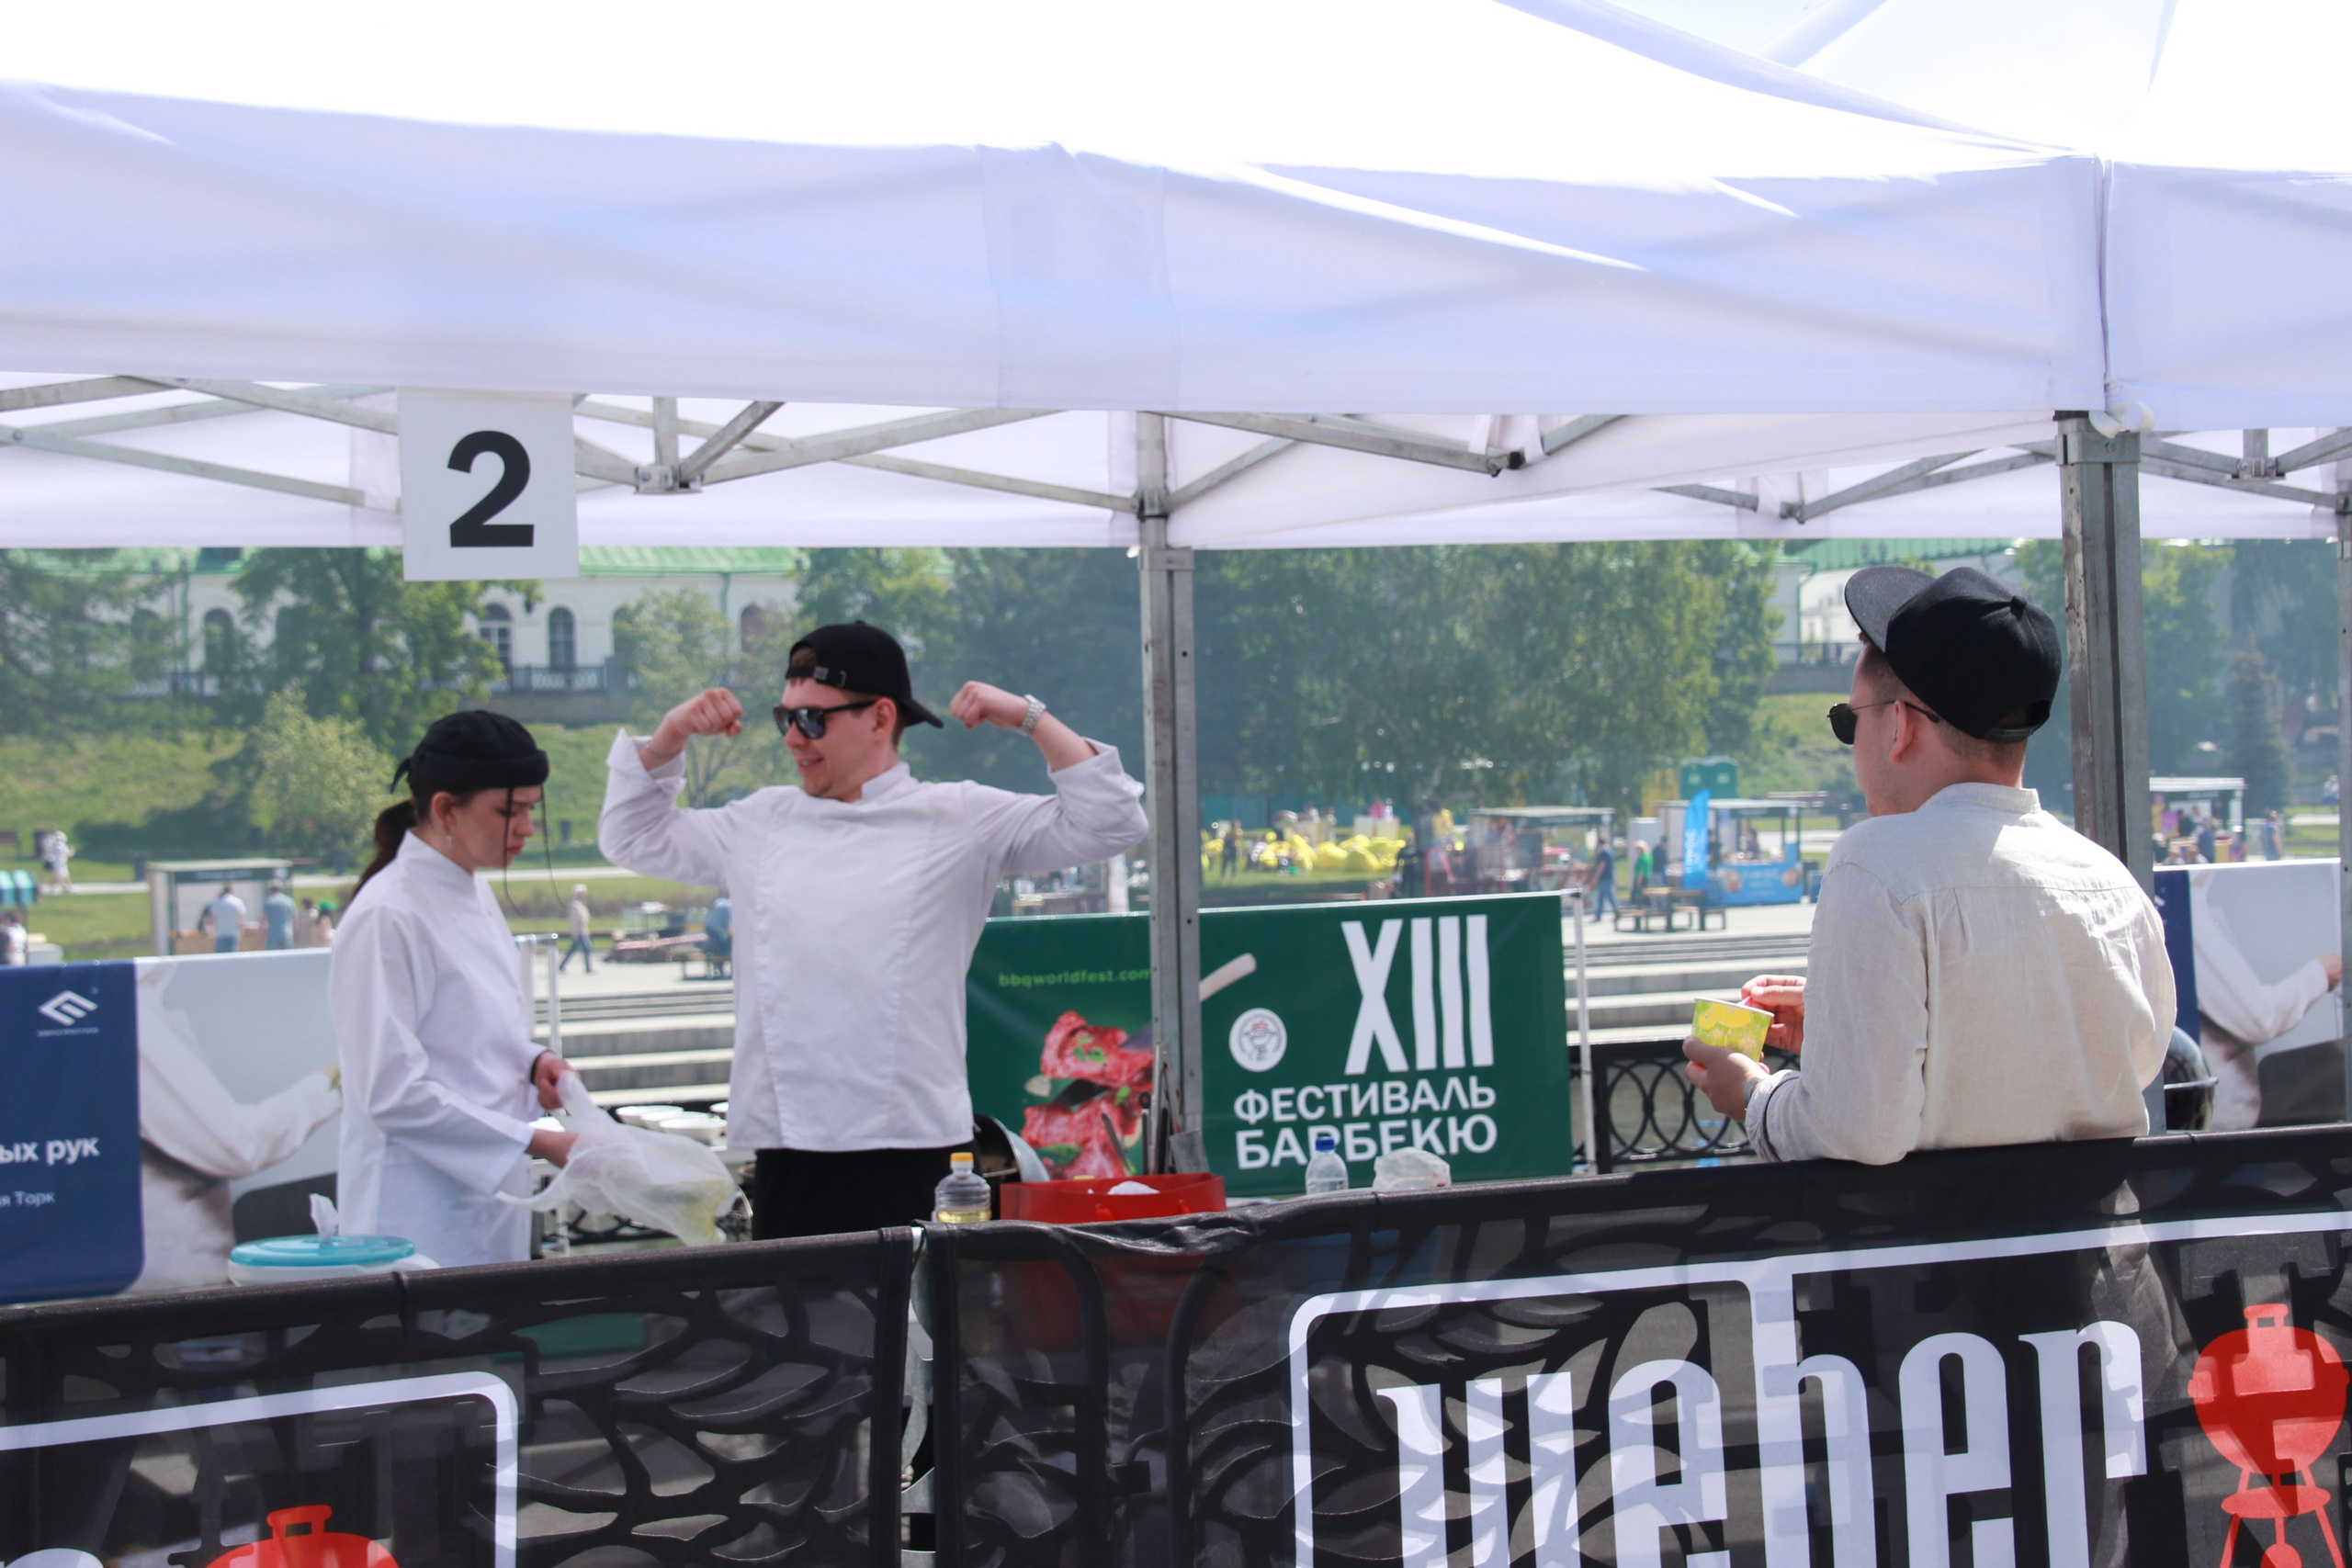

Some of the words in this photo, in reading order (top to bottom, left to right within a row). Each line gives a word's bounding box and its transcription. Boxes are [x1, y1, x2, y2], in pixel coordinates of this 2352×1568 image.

[447, 430, 535, 547] 2
[1340, 914, 1494, 1076] XIII
[1234, 1076, 1497, 1125] ФЕСТИВАЛЬ
[46, 1137, 101, 1166] рук
[1236, 1114, 1498, 1170] БАРБЕКЮ
[13, 1190, 55, 1208] Торк
